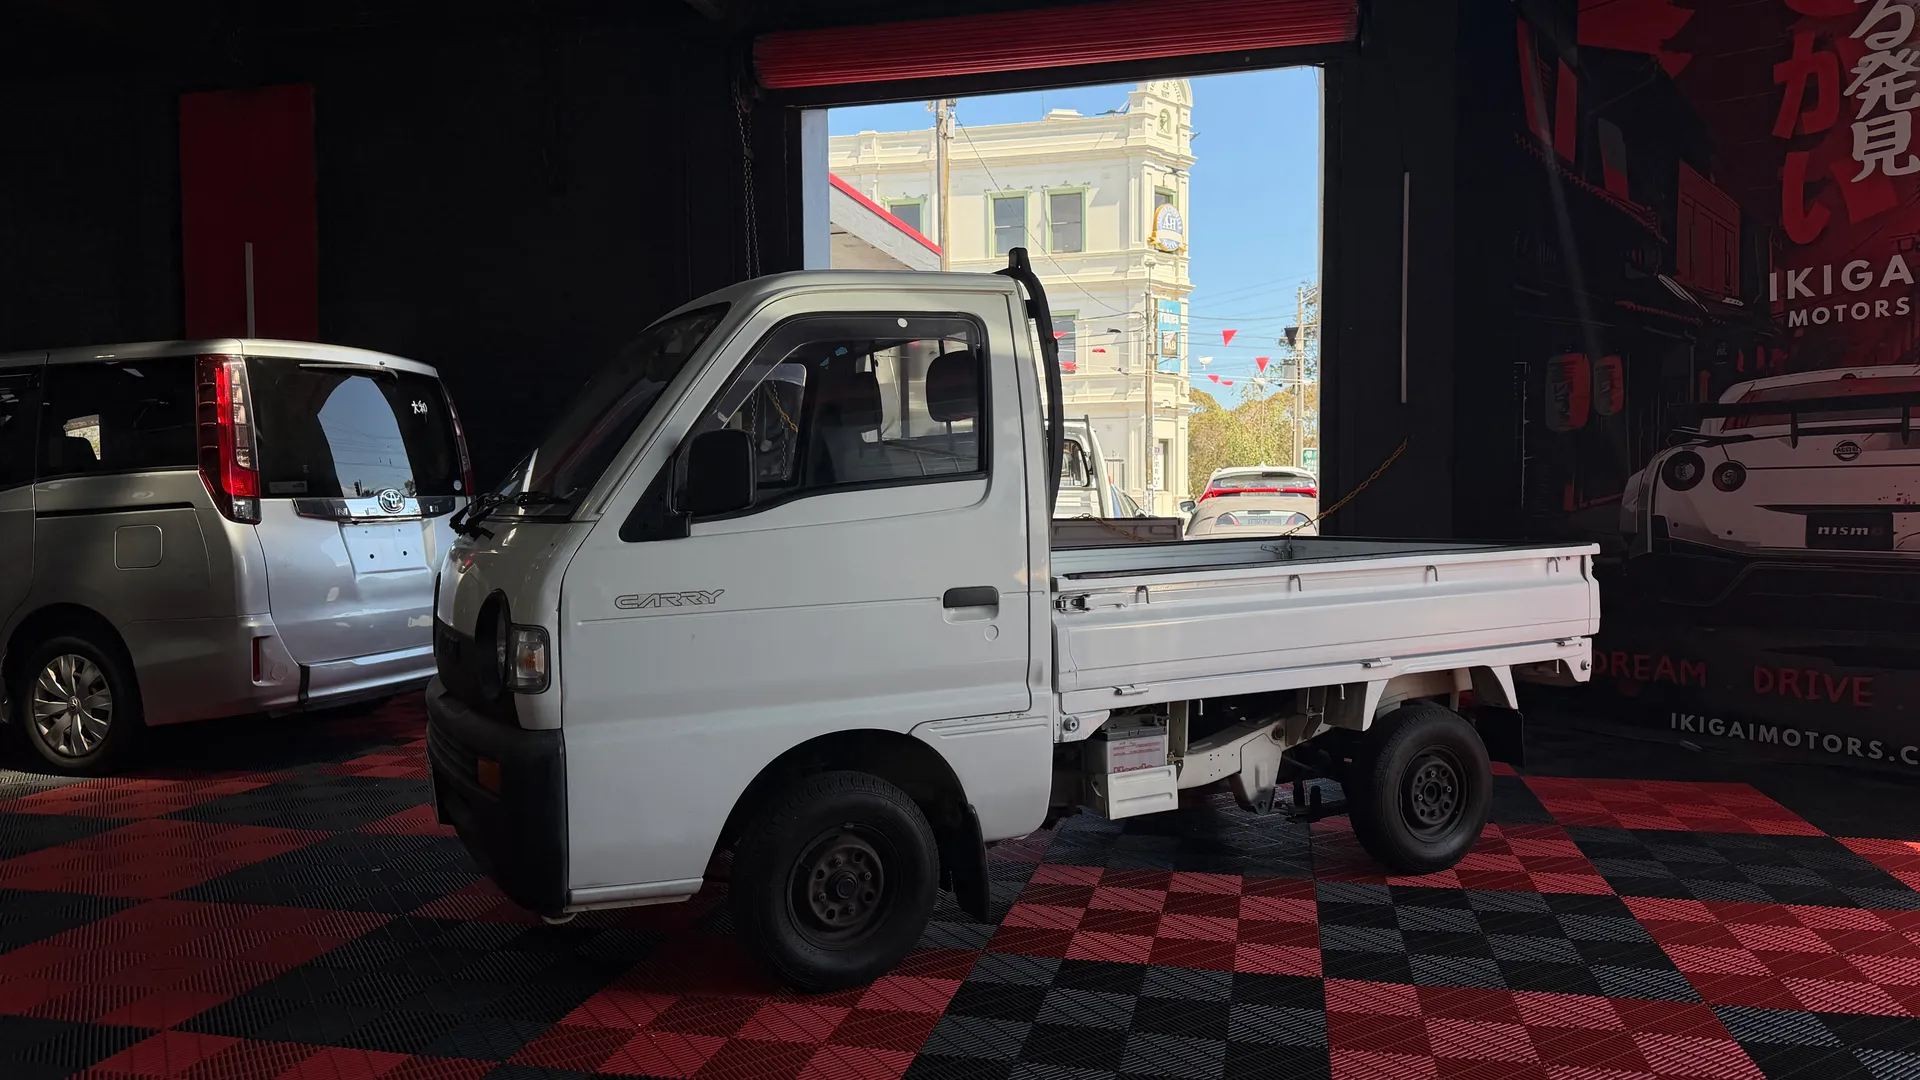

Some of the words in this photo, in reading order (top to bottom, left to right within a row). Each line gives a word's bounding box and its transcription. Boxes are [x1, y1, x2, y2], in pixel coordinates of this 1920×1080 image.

[1769, 254, 1916, 302] IKIGA
[1788, 296, 1911, 328] MOTORS
[1164, 340, 1176, 350] TAB
[614, 589, 725, 609] CARRY
[1592, 651, 1708, 688] DREAM
[1753, 664, 1875, 708] DRIVE
[1670, 712, 1920, 765] IKIGAIMOTORS.C
